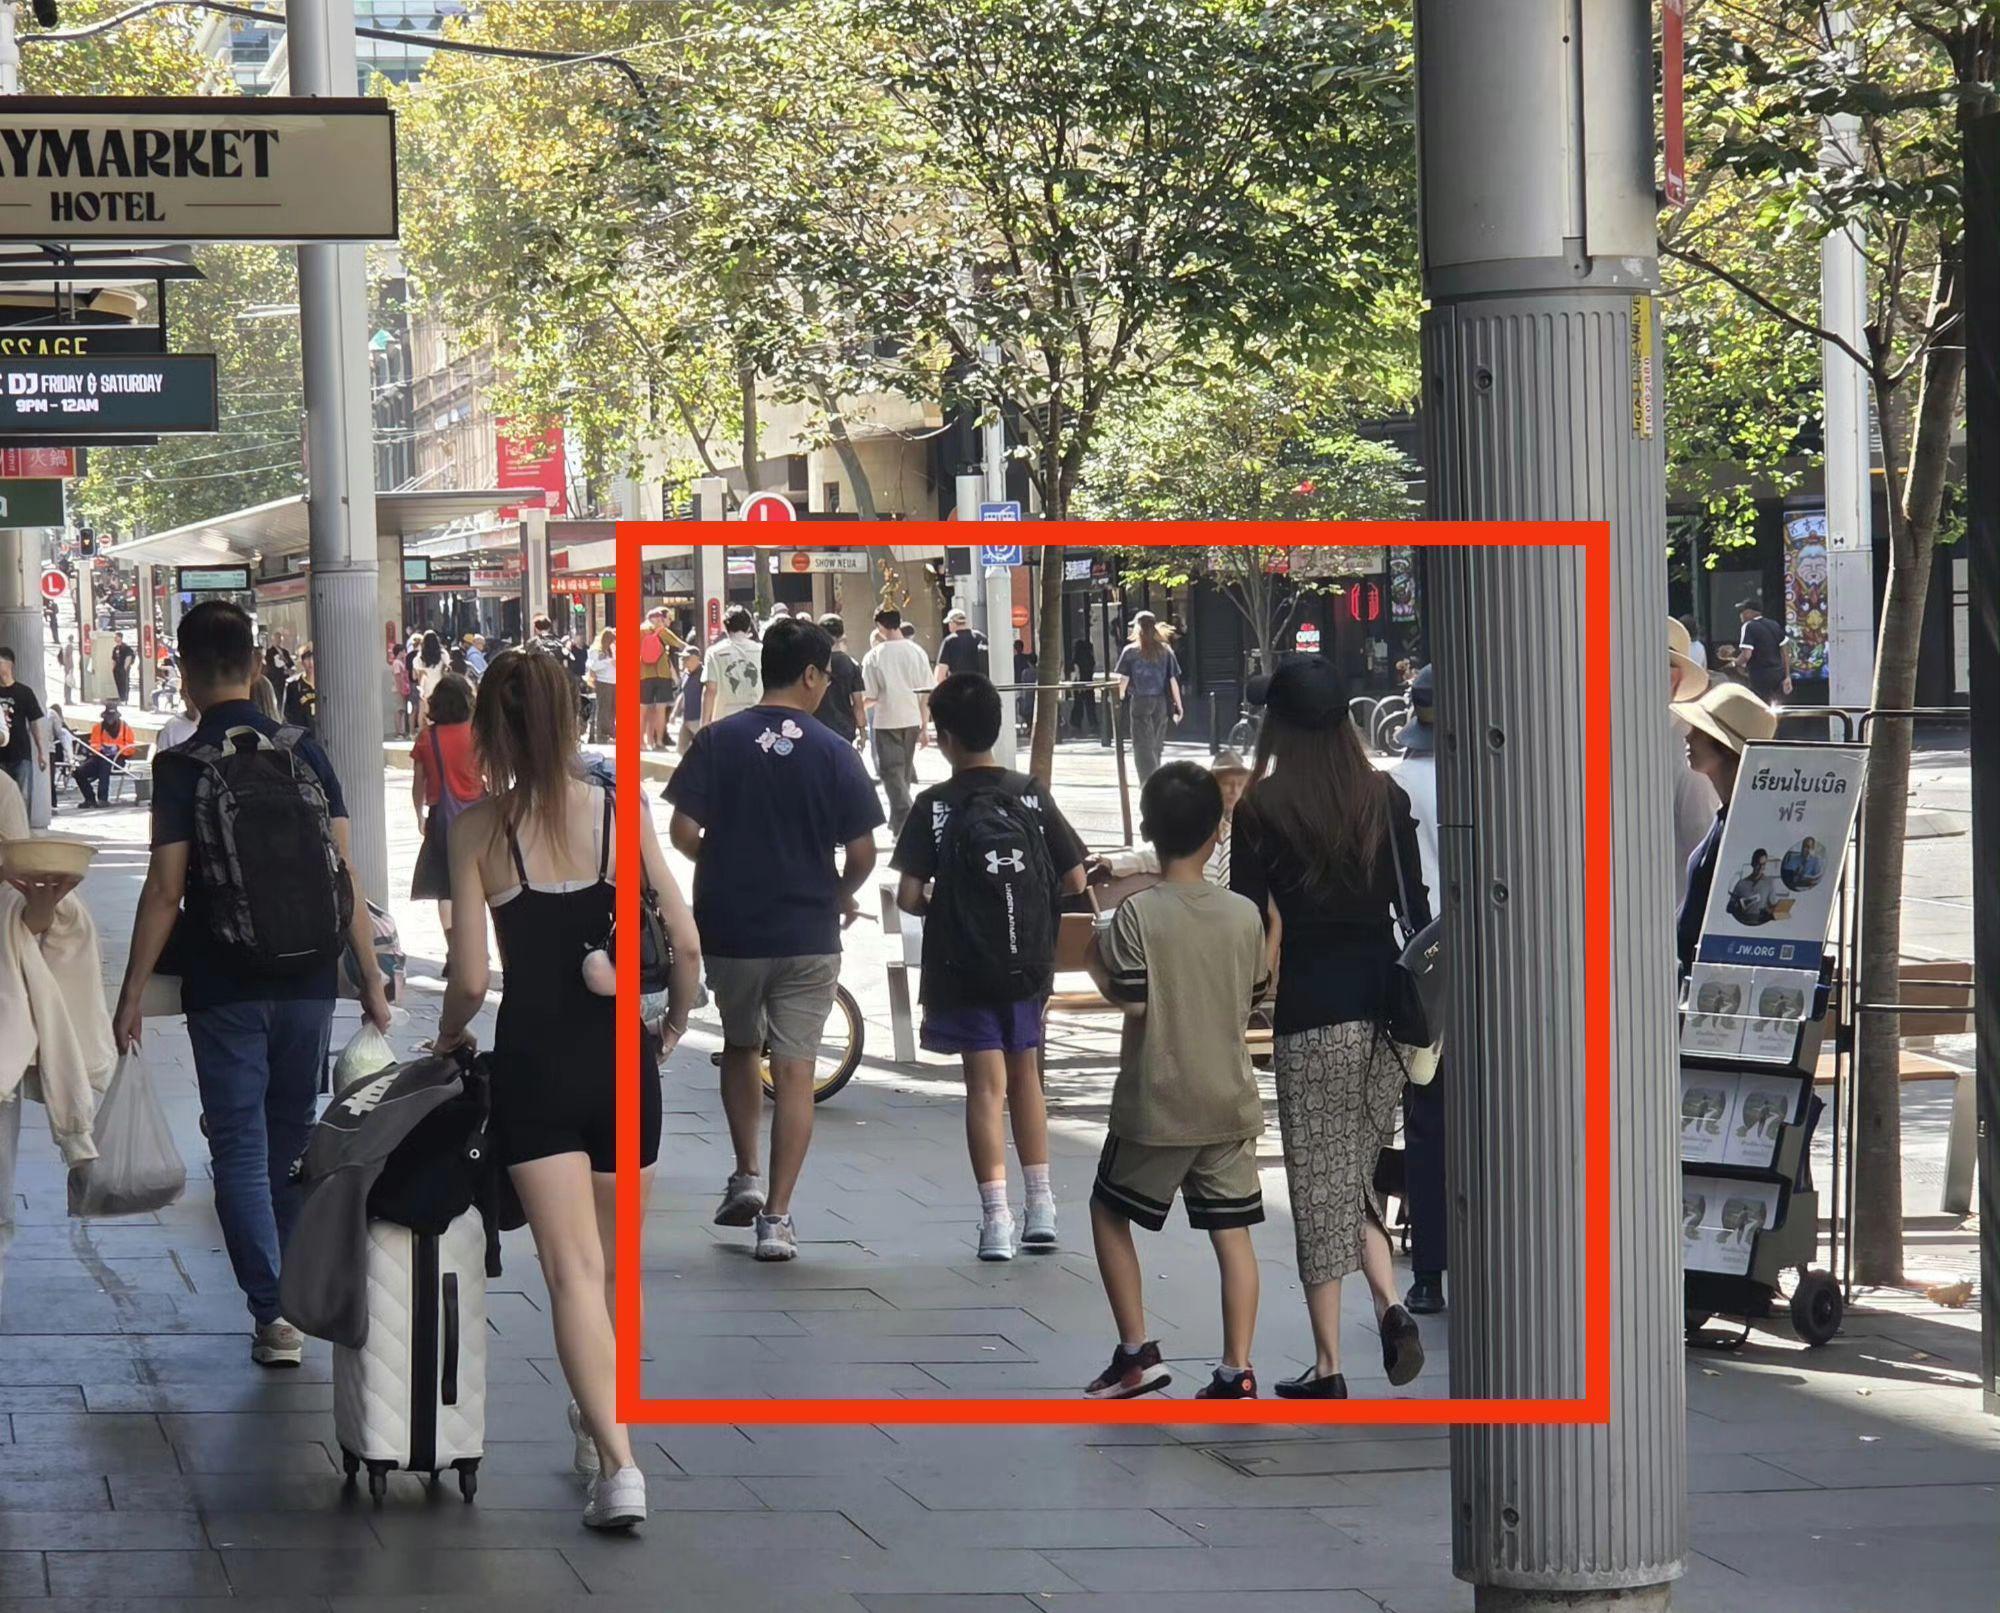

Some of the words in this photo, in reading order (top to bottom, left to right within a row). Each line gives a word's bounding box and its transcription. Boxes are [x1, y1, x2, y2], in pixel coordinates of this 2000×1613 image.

[0, 128, 280, 178] YMARKET
[50, 191, 165, 222] HOTEL
[7, 373, 38, 395] DJ
[41, 374, 84, 393] FRIDAY
[87, 372, 97, 395] &
[100, 374, 163, 393] SATURDAY
[15, 399, 48, 412] 9PM
[61, 399, 99, 412] 12AM
[48, 575, 60, 593] L
[1751, 768, 1847, 794] เรียนไบเบิล
[1778, 800, 1807, 822] ฟรี
[1005, 882, 1014, 914] UNDER
[1008, 914, 1018, 954] ARMOUR
[1736, 944, 1775, 957] JW.ORG
